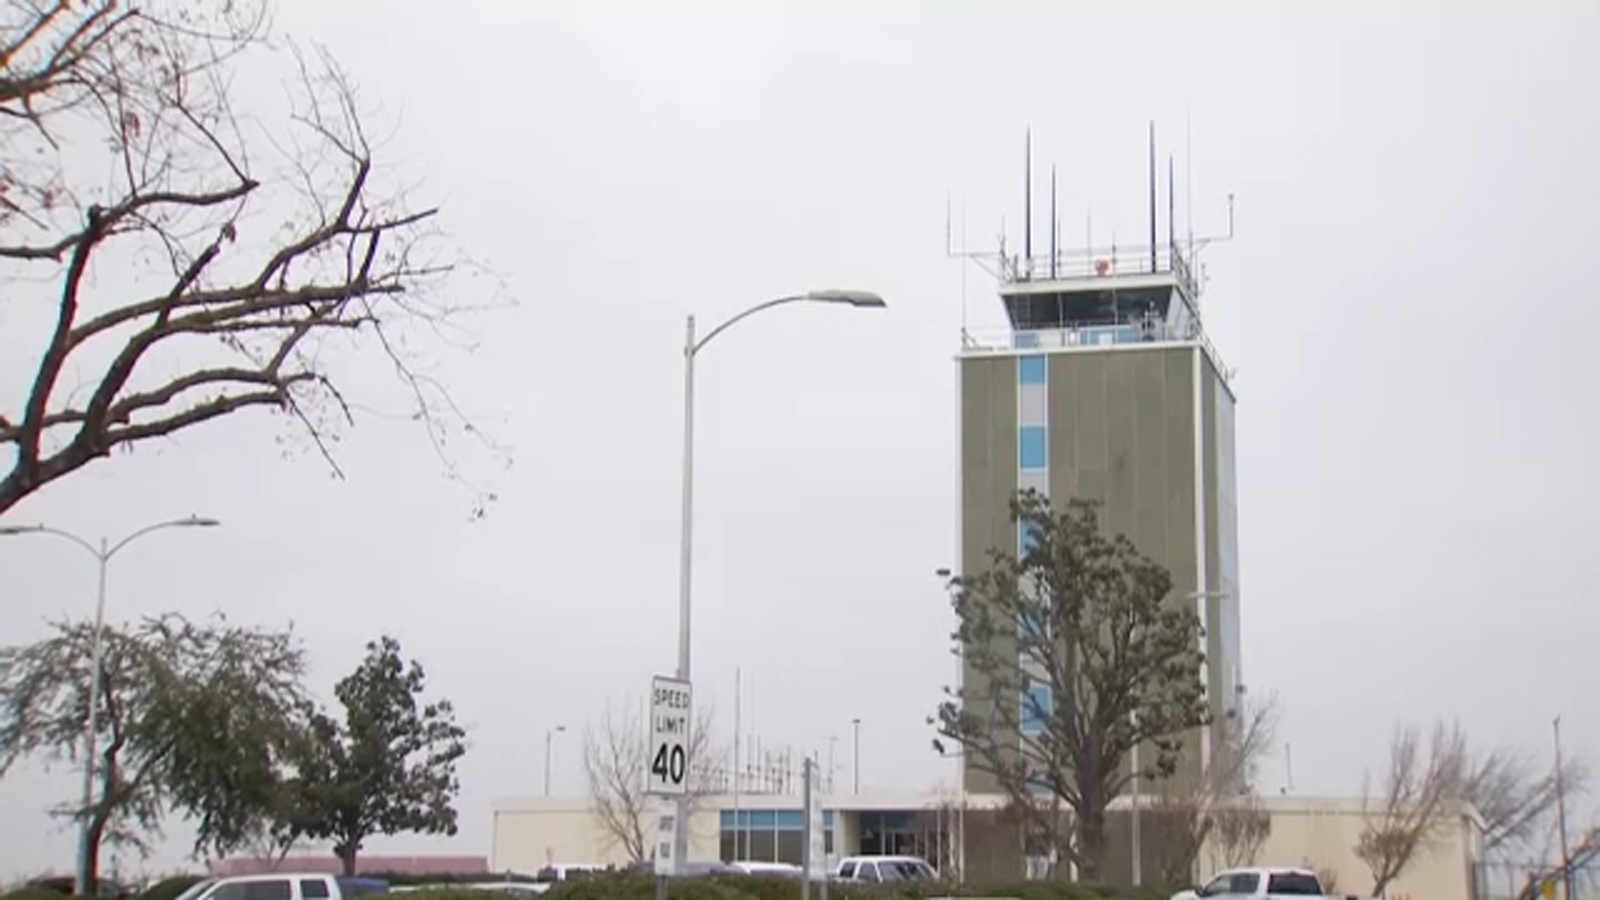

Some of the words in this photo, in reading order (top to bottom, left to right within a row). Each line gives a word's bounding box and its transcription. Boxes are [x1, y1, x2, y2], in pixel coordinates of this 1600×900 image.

[654, 688, 689, 708] SPEED
[656, 715, 685, 735] LIMIT
[652, 742, 685, 784] 40
